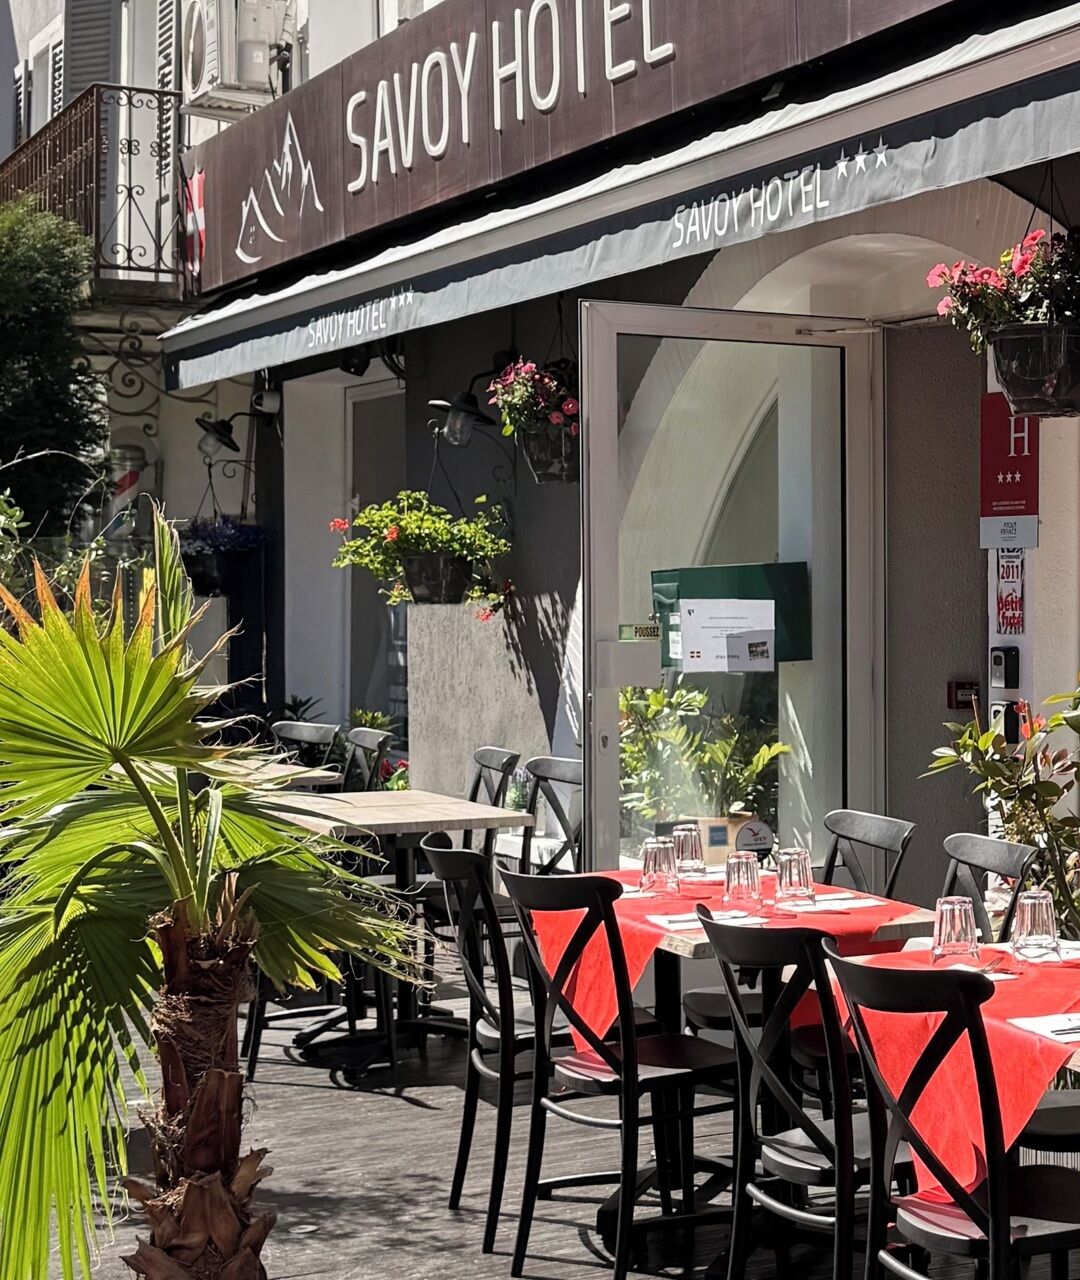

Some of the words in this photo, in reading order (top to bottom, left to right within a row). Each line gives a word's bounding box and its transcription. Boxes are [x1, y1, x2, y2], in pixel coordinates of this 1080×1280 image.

[346, 31, 477, 193] SAVOY
[672, 187, 745, 248] SAVOY
[750, 162, 830, 227] HOTEL
[307, 308, 347, 349] SAVOY
[347, 299, 387, 337] HOTEL
[1007, 416, 1031, 457] H
[1001, 564, 1019, 580] 2011
[634, 626, 660, 638] POUSSEZ
